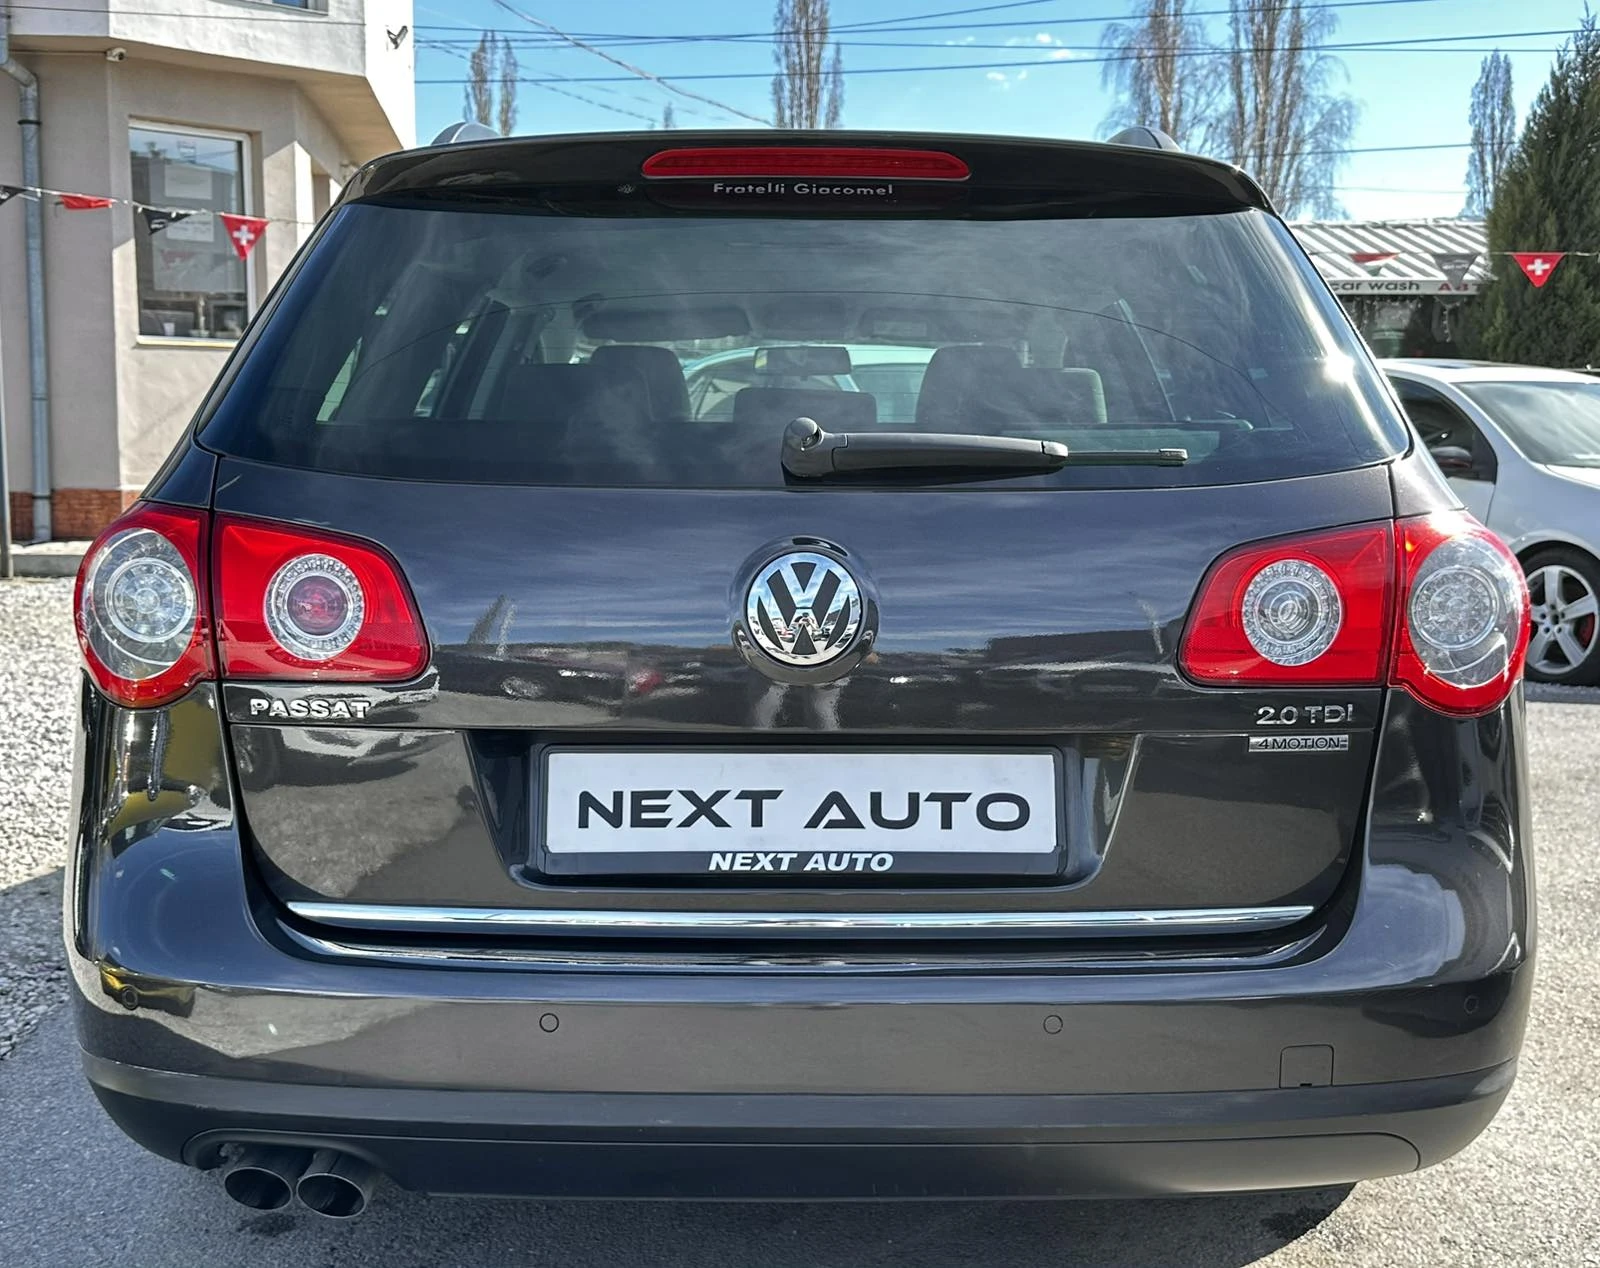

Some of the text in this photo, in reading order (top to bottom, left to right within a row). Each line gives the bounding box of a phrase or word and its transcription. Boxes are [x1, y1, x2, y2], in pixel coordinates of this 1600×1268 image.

[713, 183, 893, 195] Fratelli Giacomel
[1331, 281, 1420, 291] car wash
[249, 698, 370, 719] PASSAT
[1256, 704, 1353, 725] 2.0 TDI
[1257, 737, 1340, 750] 4MOTION
[578, 790, 1030, 831] NEXT AUTO
[708, 852, 893, 872] NEXT AUTO
